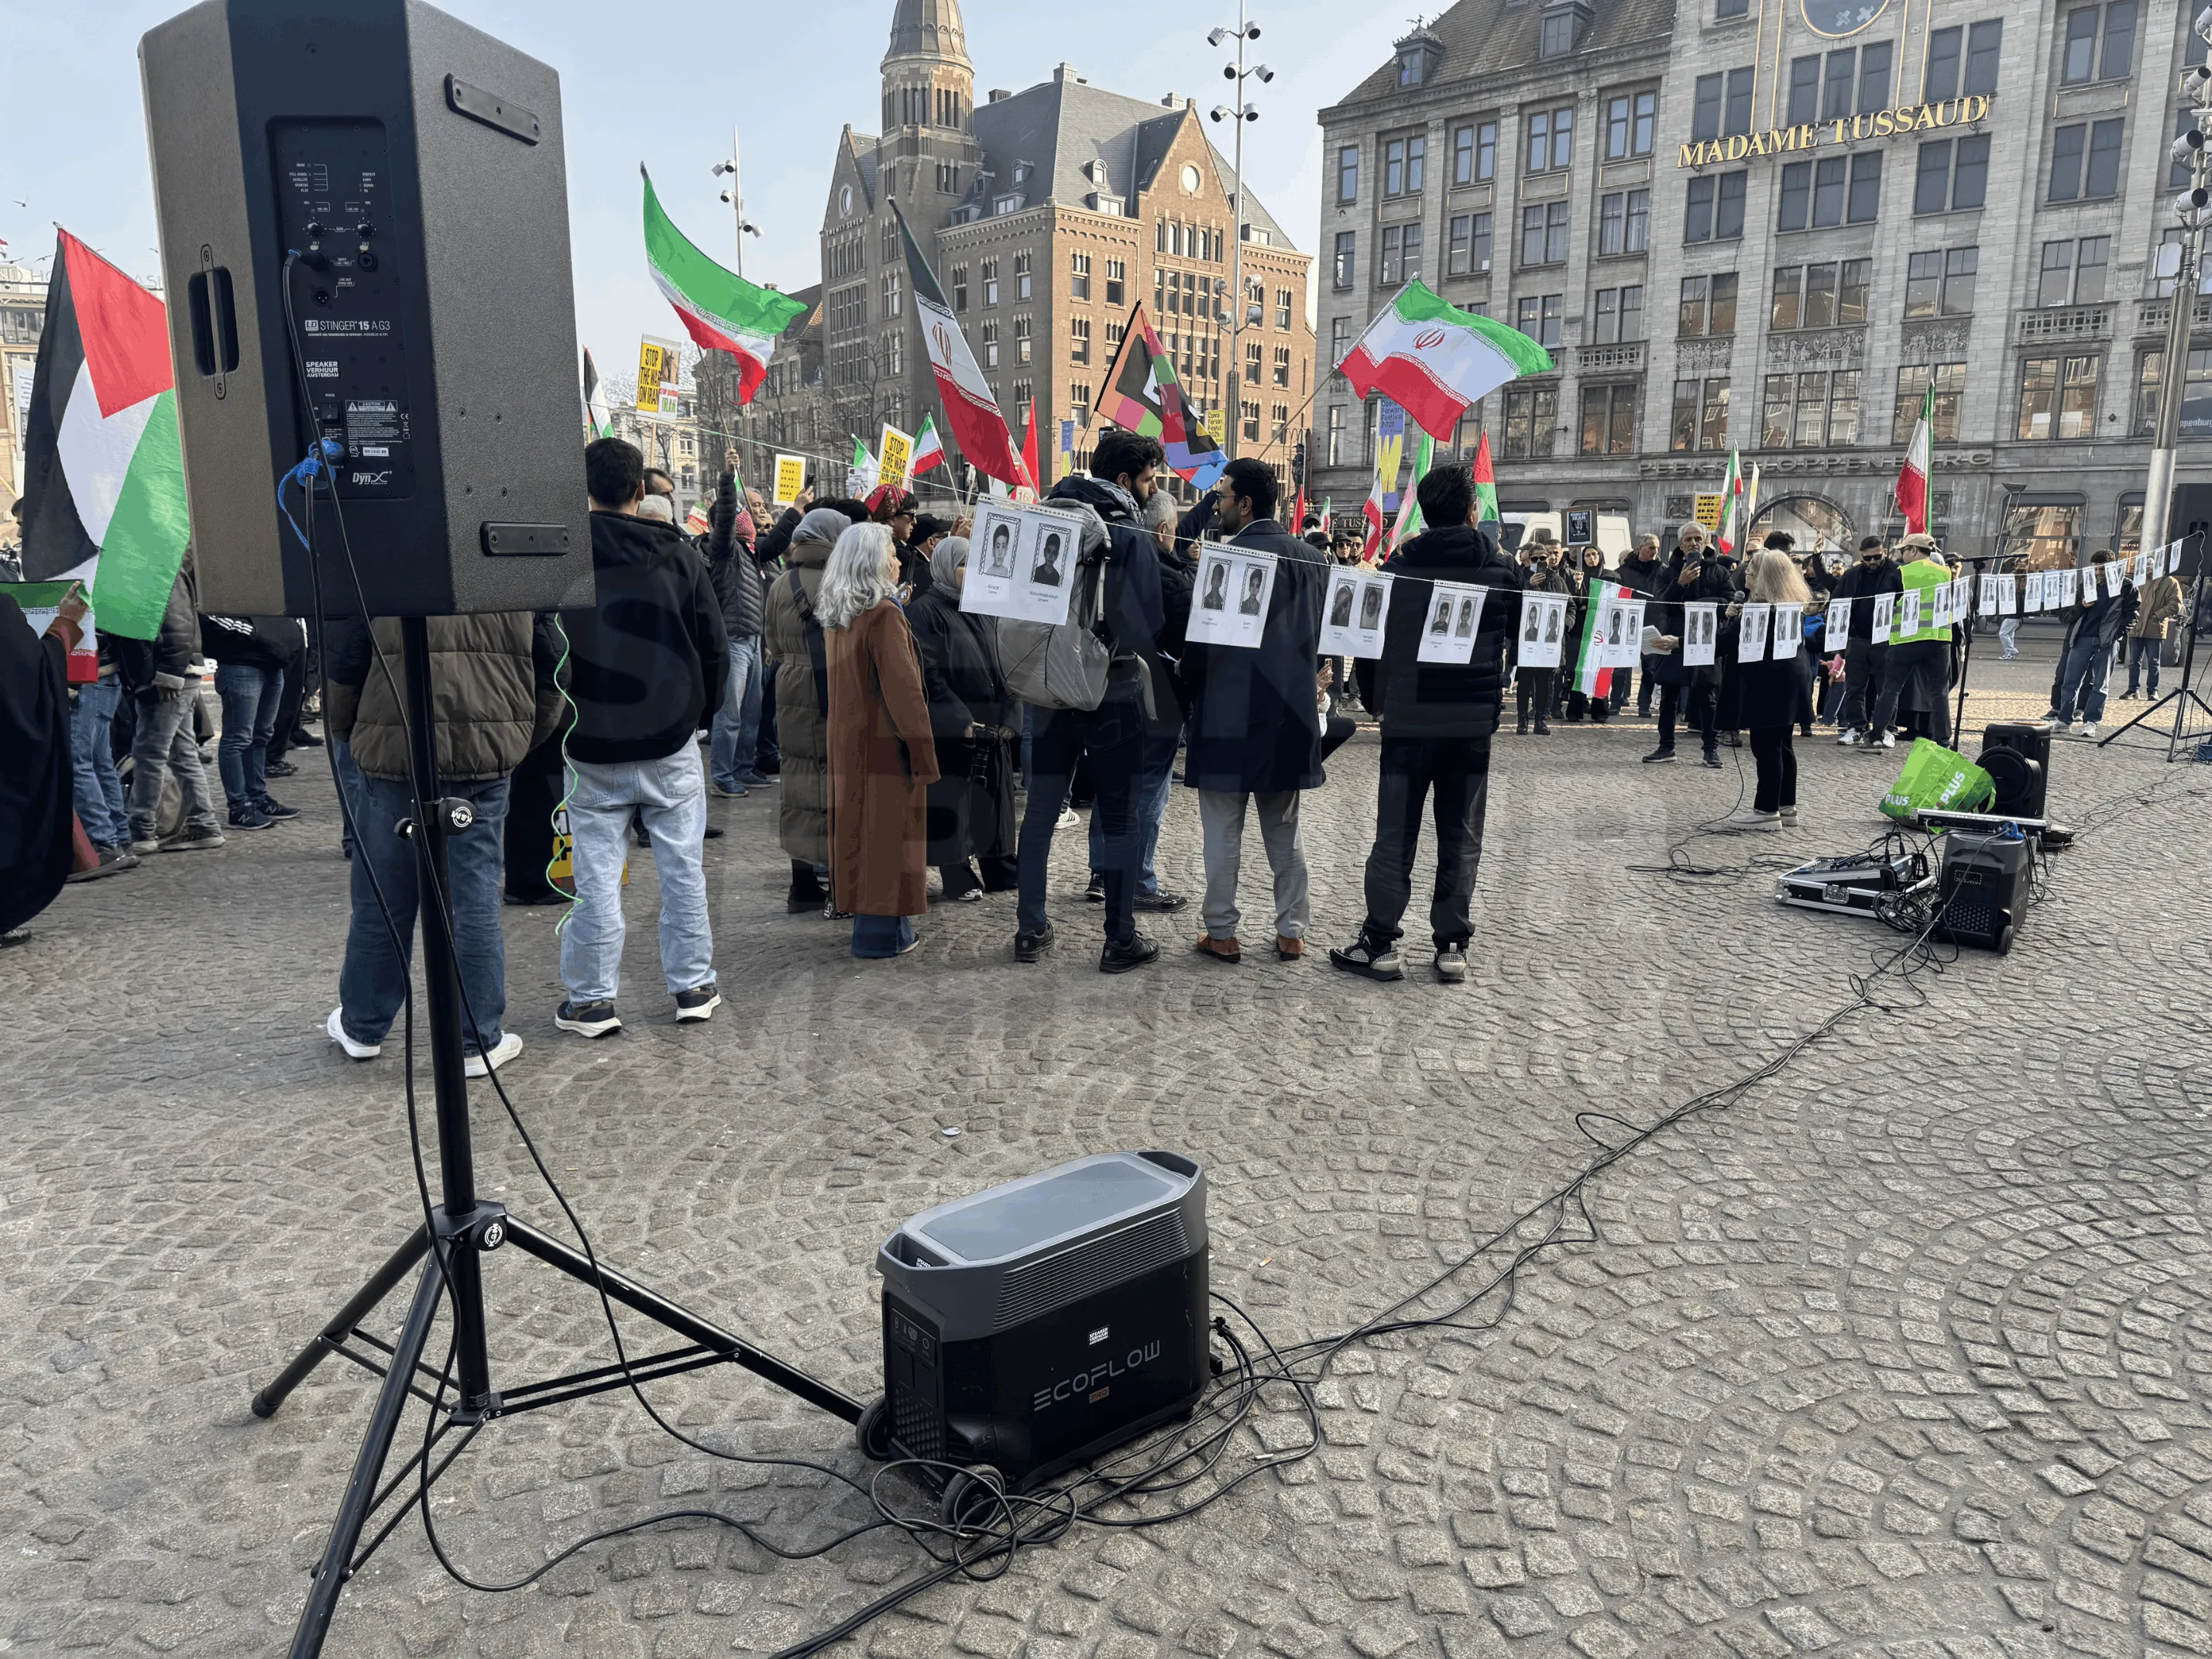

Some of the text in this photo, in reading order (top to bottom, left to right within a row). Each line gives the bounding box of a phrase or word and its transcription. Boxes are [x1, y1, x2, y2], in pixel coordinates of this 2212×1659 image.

[1678, 94, 1990, 168] MADAME TUSSAUD
[358, 321, 370, 331] 15
[371, 321, 378, 331] A
[379, 321, 390, 331] G3
[645, 348, 659, 367] STOP
[641, 366, 651, 386] THE
[639, 386, 647, 404] ON
[889, 436, 905, 455] STOP
[883, 450, 906, 473] THE WAR
[1640, 462, 1707, 475] PEEK
[1743, 453, 1991, 472] CLOPPENBRG
[881, 466, 889, 483] ON
[890, 471, 903, 489] IRAN
[1939, 770, 1966, 805] PLUS
[1885, 794, 1910, 806] PLUS
[451, 810, 473, 823] K&M
[488, 1223, 499, 1247] K&M
[1089, 1327, 1108, 1338] SPEAKER
[1034, 1339, 1160, 1412] ECOFLOW
[1091, 1389, 1108, 1401] PRO
